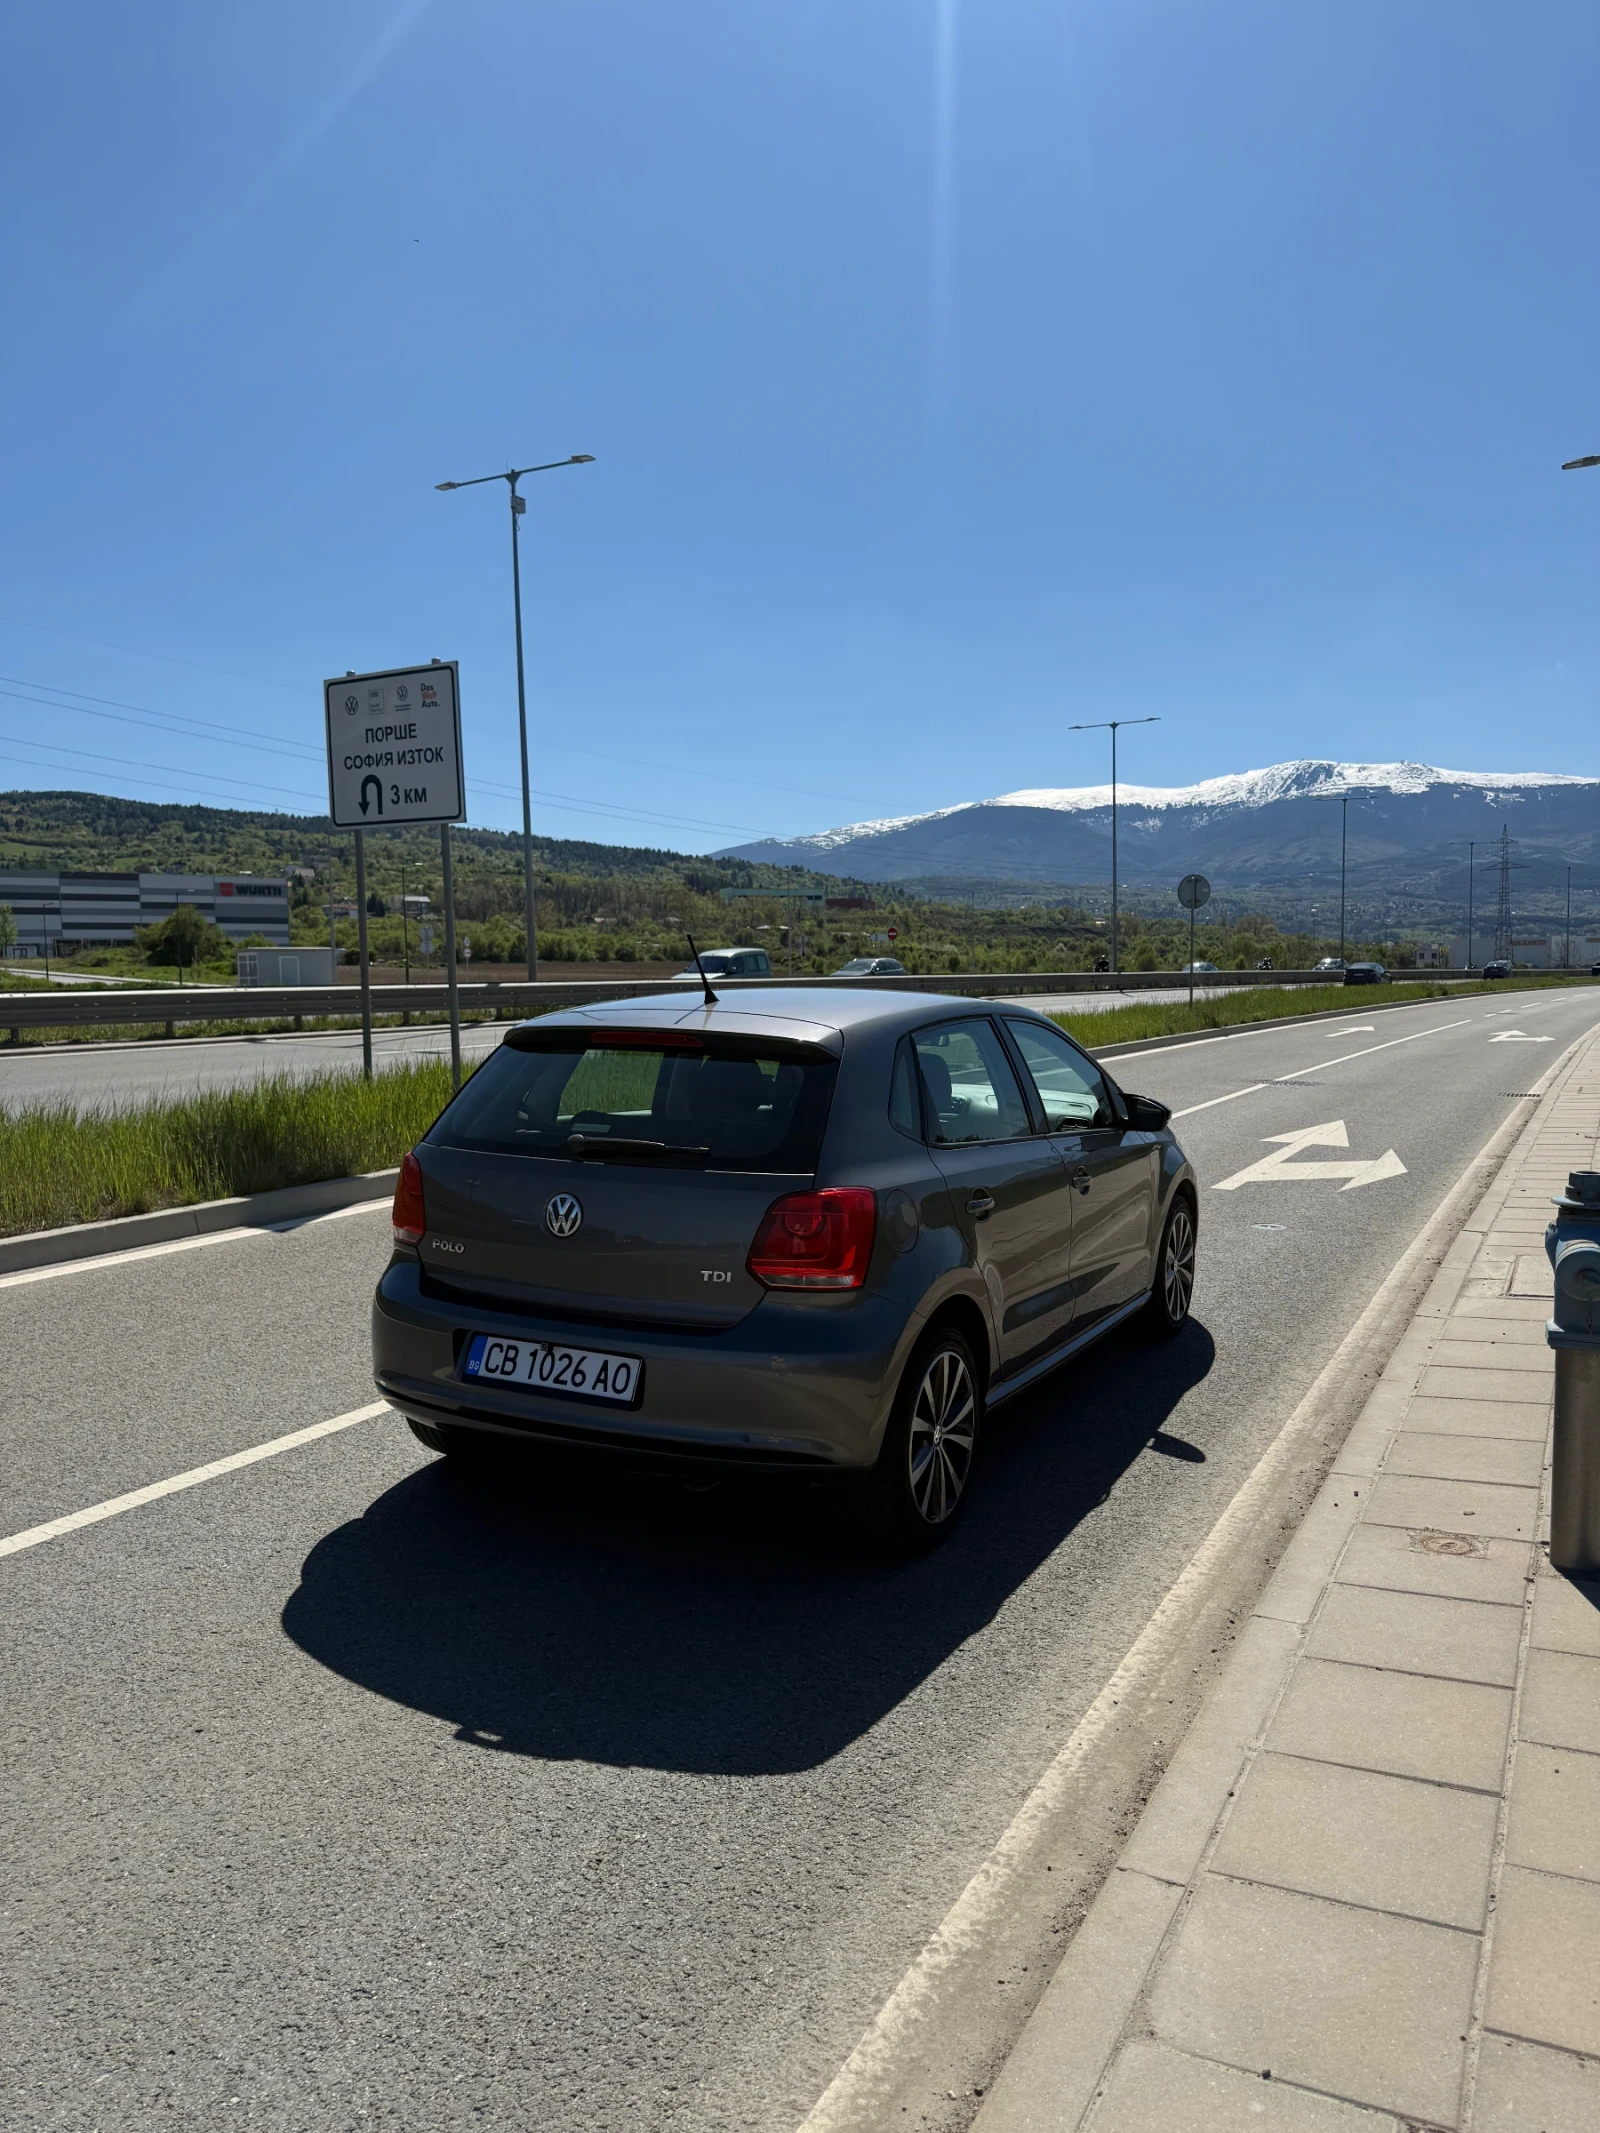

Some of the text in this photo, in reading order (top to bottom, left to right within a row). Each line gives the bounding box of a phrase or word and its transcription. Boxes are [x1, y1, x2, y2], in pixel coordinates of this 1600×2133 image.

[421, 683, 434, 692] Das
[422, 691, 437, 700] Welt
[365, 723, 417, 743] ПОРШЕ
[344, 746, 444, 770] СОФИЯ ИЗТОК
[390, 785, 401, 804] 3
[432, 1239, 465, 1253] POLO
[701, 1270, 732, 1283] TDI
[468, 1360, 480, 1370] BG
[484, 1343, 631, 1394] CB 1026 AO
